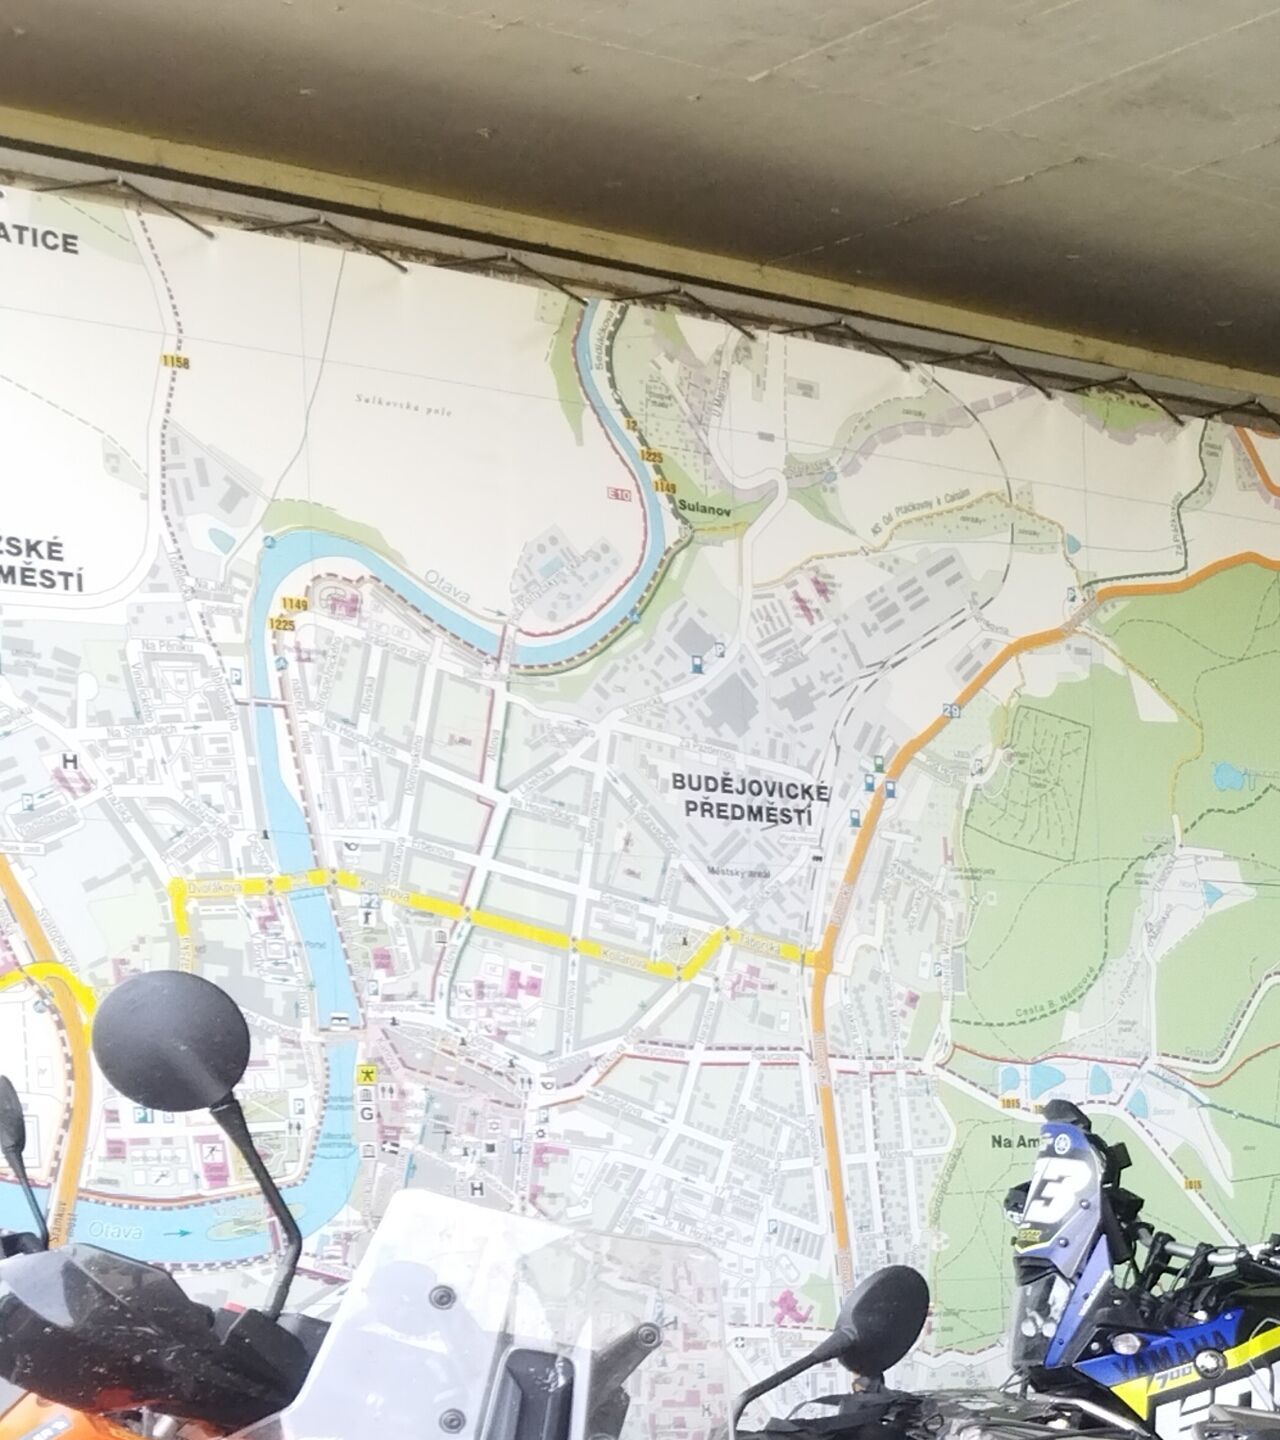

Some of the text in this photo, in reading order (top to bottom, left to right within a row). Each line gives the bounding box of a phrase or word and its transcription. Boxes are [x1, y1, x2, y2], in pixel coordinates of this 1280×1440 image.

[161, 354, 190, 369] 1158
[641, 450, 664, 464] 1225
[609, 489, 630, 500] E10
[679, 500, 731, 517] Sulanov
[0, 536, 64, 562] SKÉ
[424, 568, 471, 604] Otava
[281, 597, 309, 612] 1149
[269, 618, 296, 632] 1225
[943, 704, 961, 718] 29
[672, 771, 831, 803] BUDĚJOVICKÉ
[684, 796, 812, 827] PŘEDMĚSTÍ
[991, 1135, 1012, 1149] Na
[89, 1220, 144, 1240] Otava
[1112, 1330, 1231, 1378] YAMAHA
[1155, 1364, 1193, 1390] 700
